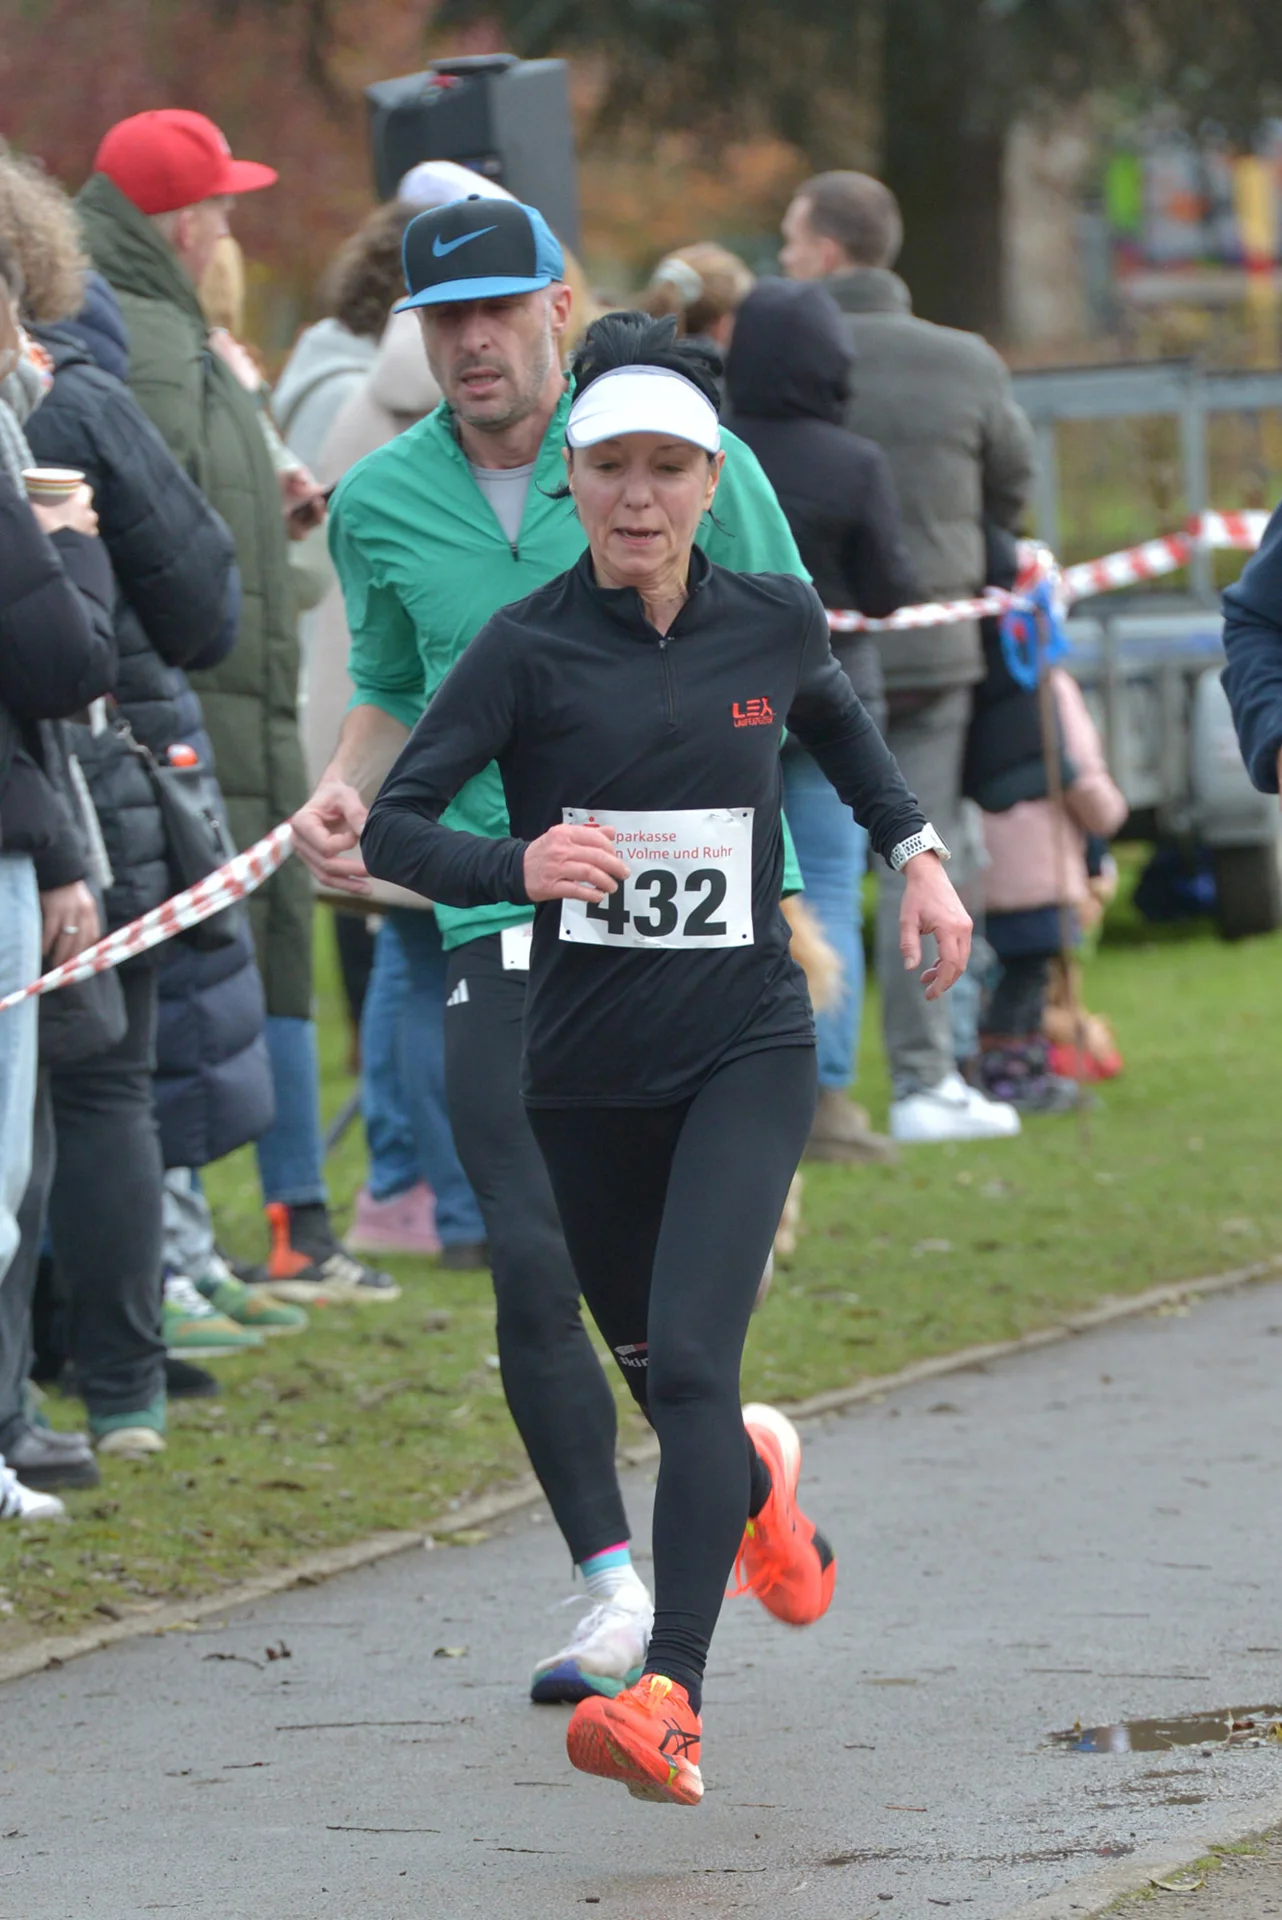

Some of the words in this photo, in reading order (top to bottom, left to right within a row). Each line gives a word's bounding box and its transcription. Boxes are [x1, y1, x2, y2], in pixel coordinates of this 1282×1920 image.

[611, 830, 677, 844] parkasse
[627, 847, 670, 860] Volme
[673, 847, 699, 859] und
[702, 845, 733, 859] Ruhr
[585, 868, 728, 937] 432
